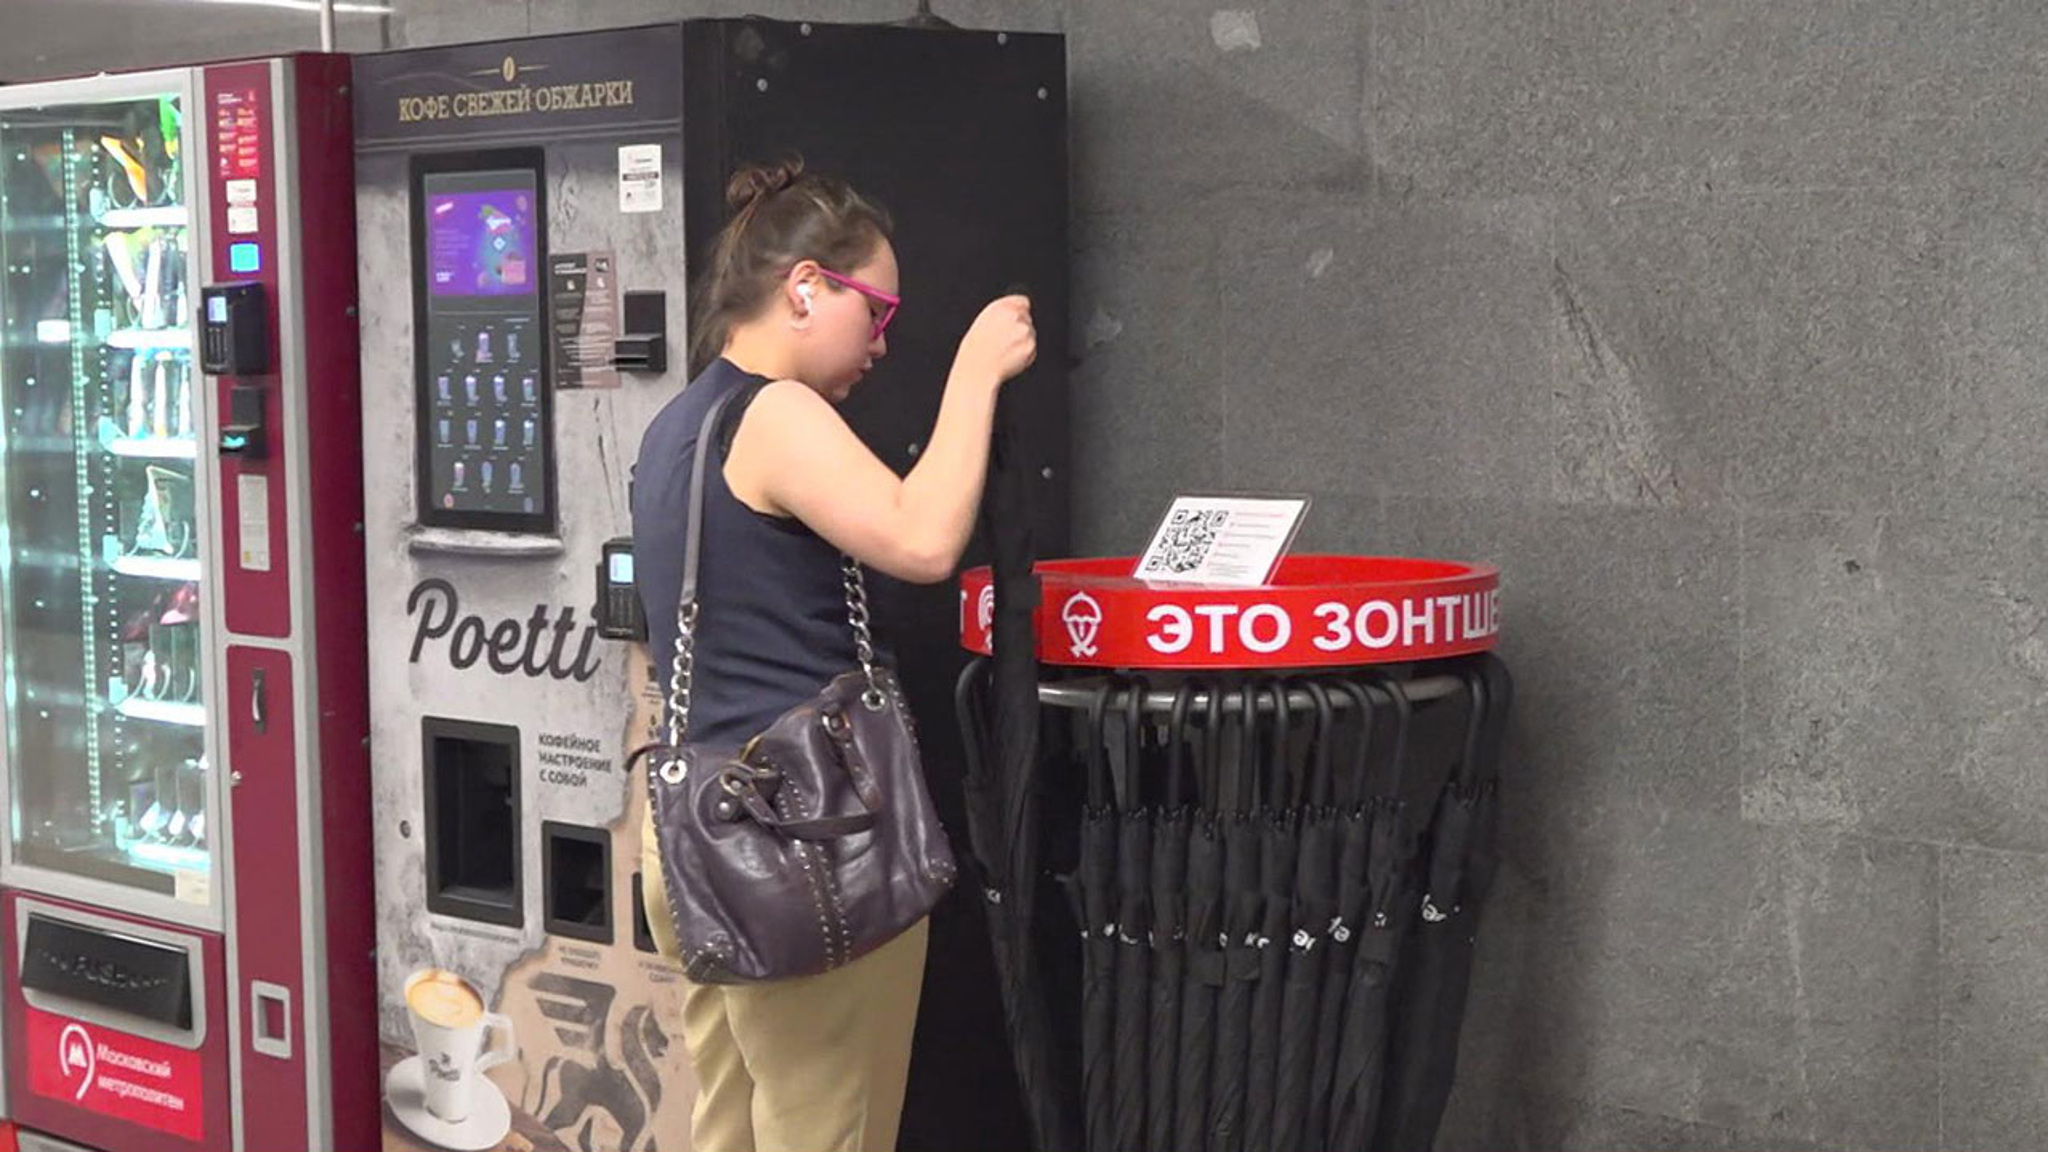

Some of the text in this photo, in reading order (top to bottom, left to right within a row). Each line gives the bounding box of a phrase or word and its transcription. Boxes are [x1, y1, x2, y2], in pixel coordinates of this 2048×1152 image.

[398, 81, 633, 121] КОФЕ СВЕЖЕЙ ОБЖАРКИ
[406, 577, 602, 682] Poetti
[1146, 603, 1292, 654] ЭТО
[538, 732, 601, 754] КОФЕЙНОЕ
[538, 751, 612, 774] НАСТРОЕНИЕ
[539, 769, 588, 788] С СОБОЙ
[96, 1042, 171, 1077] Московский
